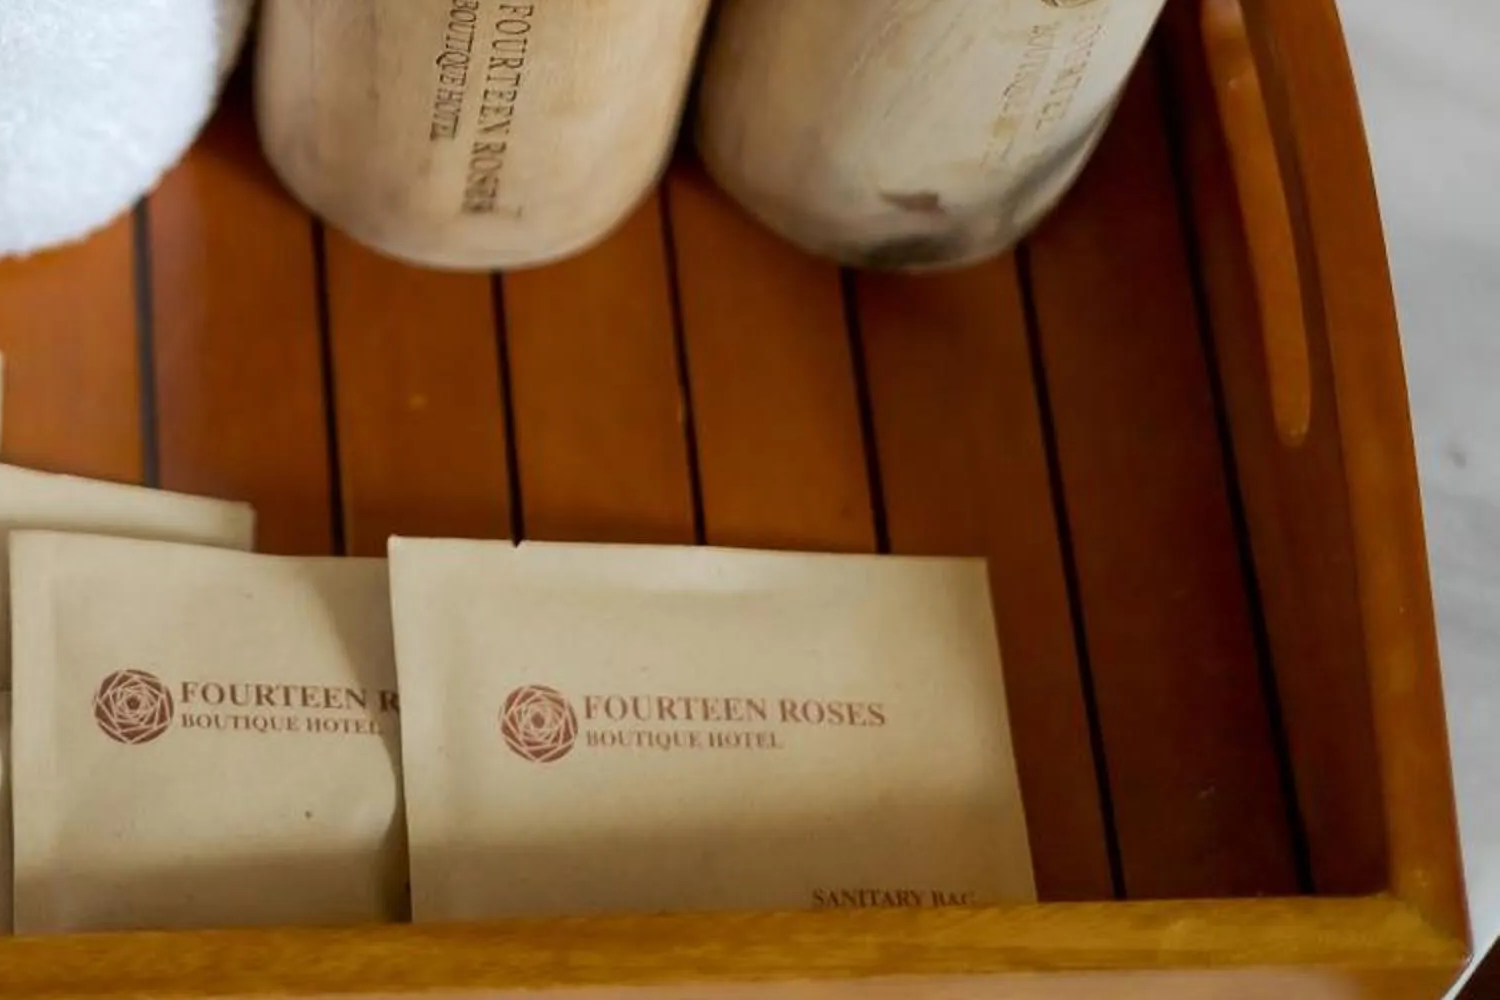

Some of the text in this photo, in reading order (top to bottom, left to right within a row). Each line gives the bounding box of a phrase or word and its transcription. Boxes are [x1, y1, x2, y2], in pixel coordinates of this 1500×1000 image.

[476, 4, 534, 135] FOURTEEN
[429, 87, 464, 142] HOTEL
[180, 681, 367, 710] FOURTEEN
[181, 713, 385, 736] BOUTIQUE HOTEL
[583, 695, 887, 727] FOURTEEN ROSES
[585, 730, 784, 751] BOUTIQUE HOTEL
[812, 888, 923, 908] SANITARY
